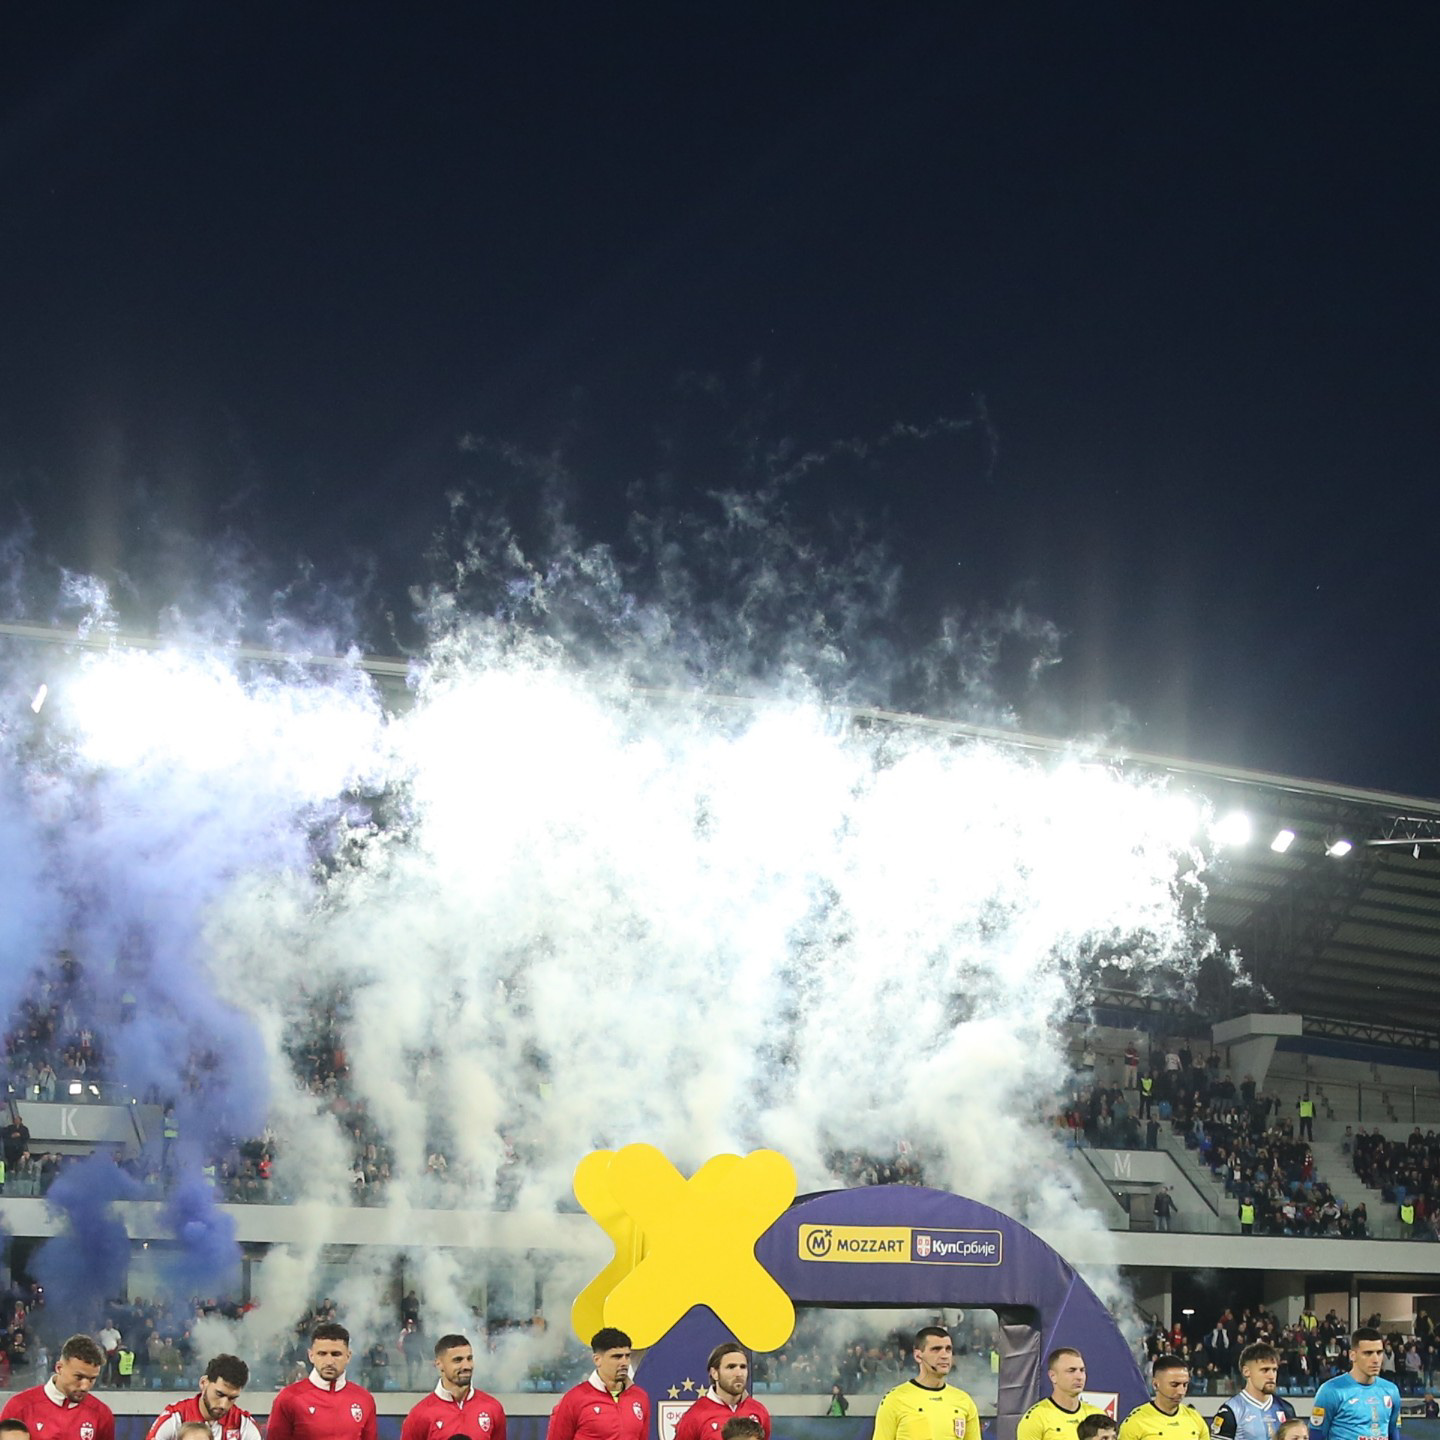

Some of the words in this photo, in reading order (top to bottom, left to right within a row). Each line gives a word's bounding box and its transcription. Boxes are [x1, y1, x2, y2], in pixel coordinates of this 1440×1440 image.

[61, 1107, 78, 1136] K
[1114, 1152, 1131, 1178] M
[836, 1239, 905, 1253] MOZZART
